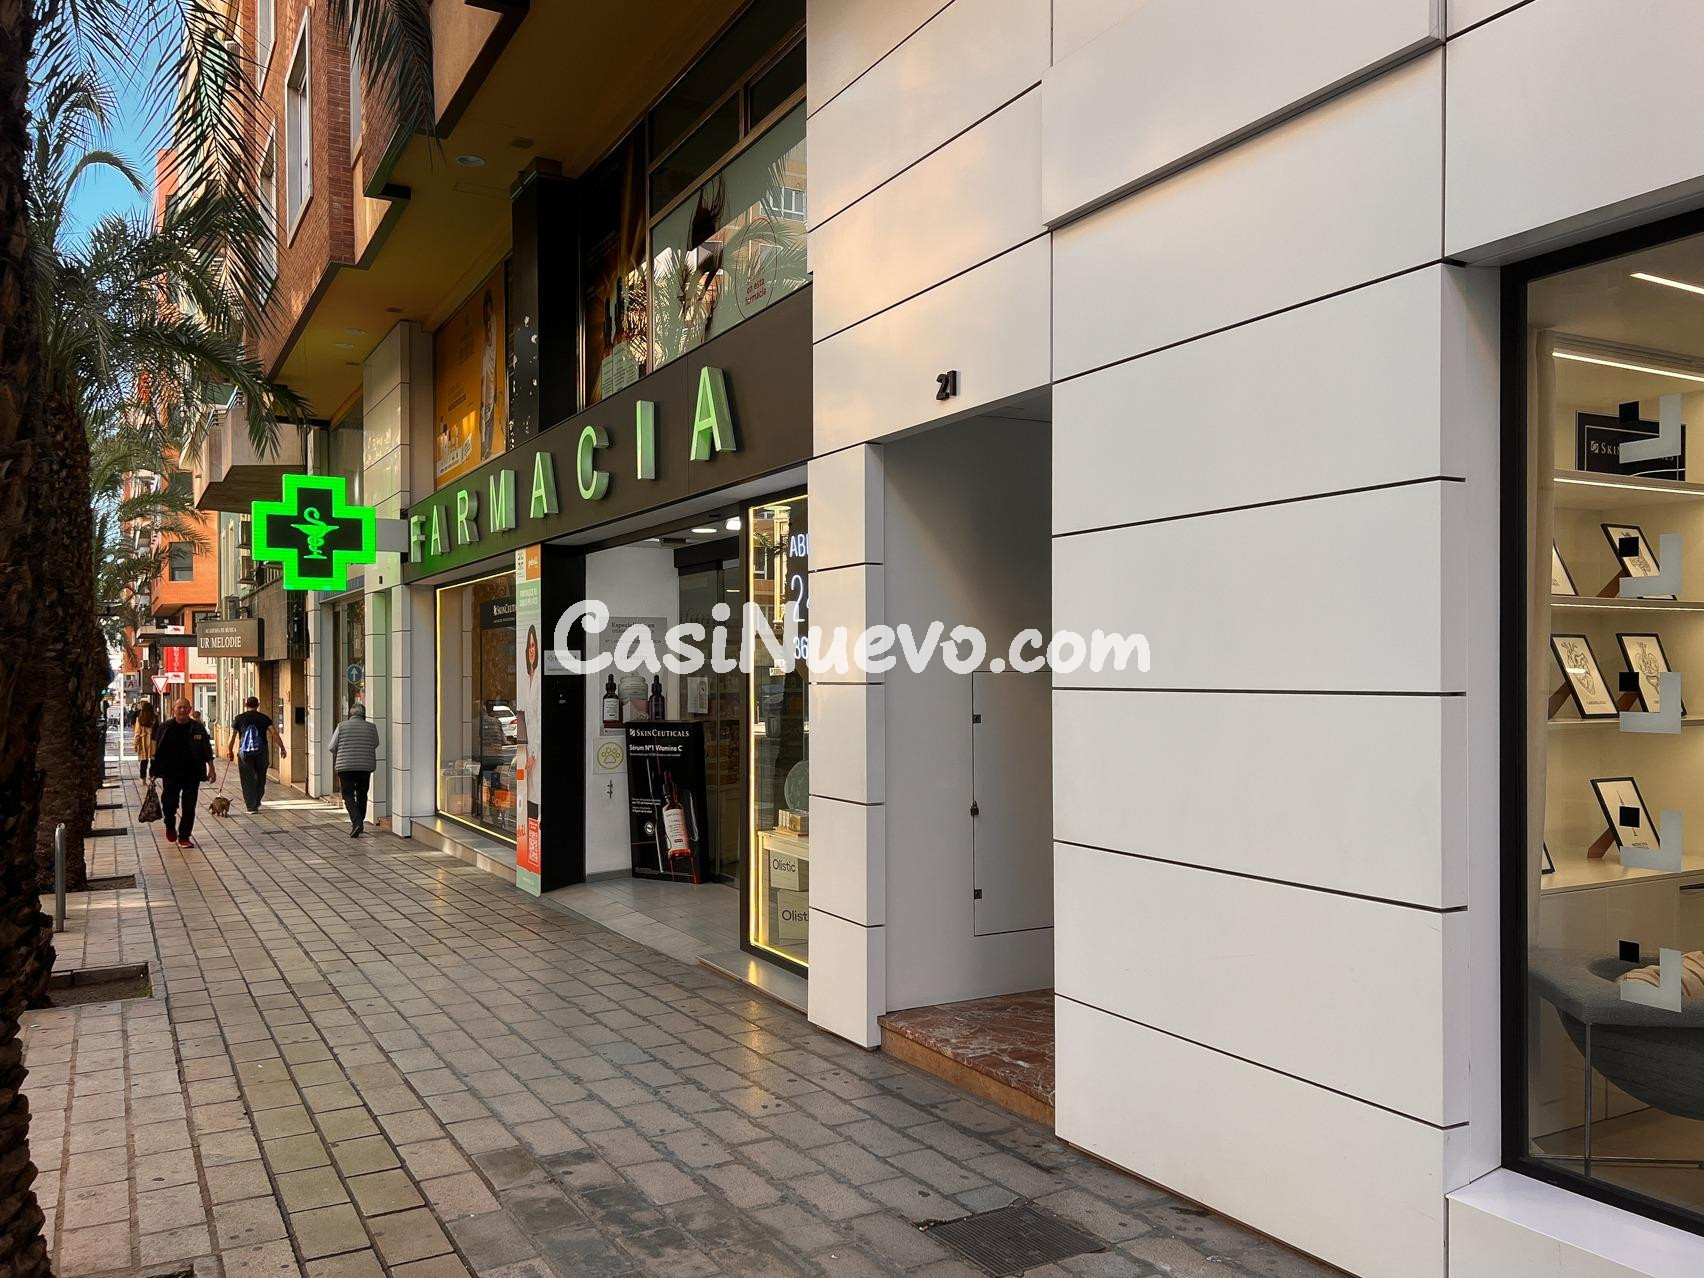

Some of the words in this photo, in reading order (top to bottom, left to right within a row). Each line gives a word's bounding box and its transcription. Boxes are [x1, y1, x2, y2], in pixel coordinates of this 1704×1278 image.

[936, 370, 957, 400] 21
[410, 366, 737, 563] FARMACIA
[200, 637, 210, 648] UR
[211, 636, 242, 648] MELODIE
[636, 729, 690, 737] SKINCEUTICALS
[772, 859, 796, 873] Olistic
